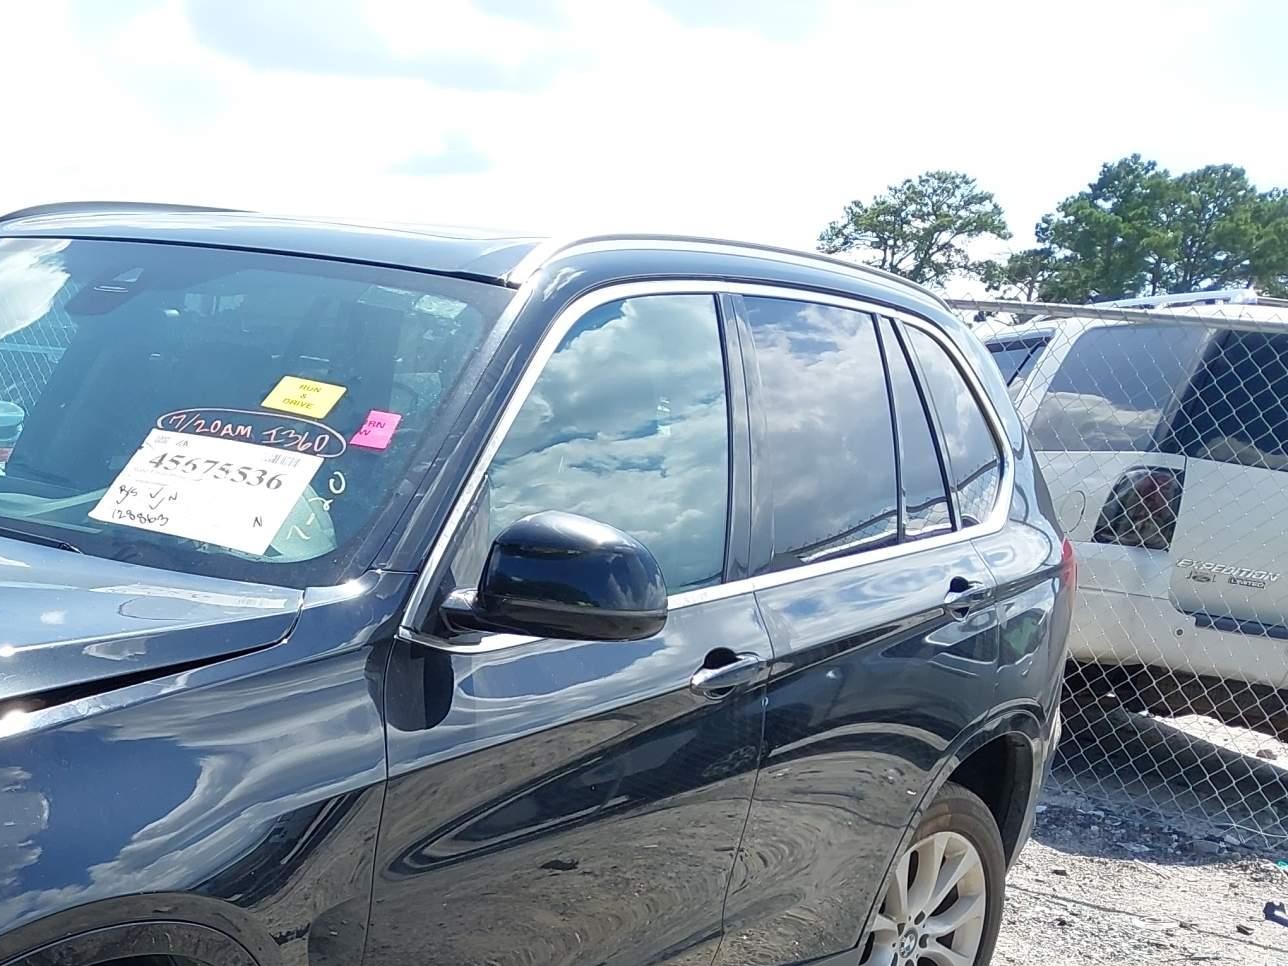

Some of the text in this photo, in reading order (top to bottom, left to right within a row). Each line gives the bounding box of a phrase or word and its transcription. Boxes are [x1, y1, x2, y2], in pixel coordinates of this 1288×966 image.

[299, 384, 322, 393] RUN
[282, 397, 314, 409] DRIVE
[149, 452, 289, 490] 45675536
[1176, 559, 1281, 581] EXPEDITION
